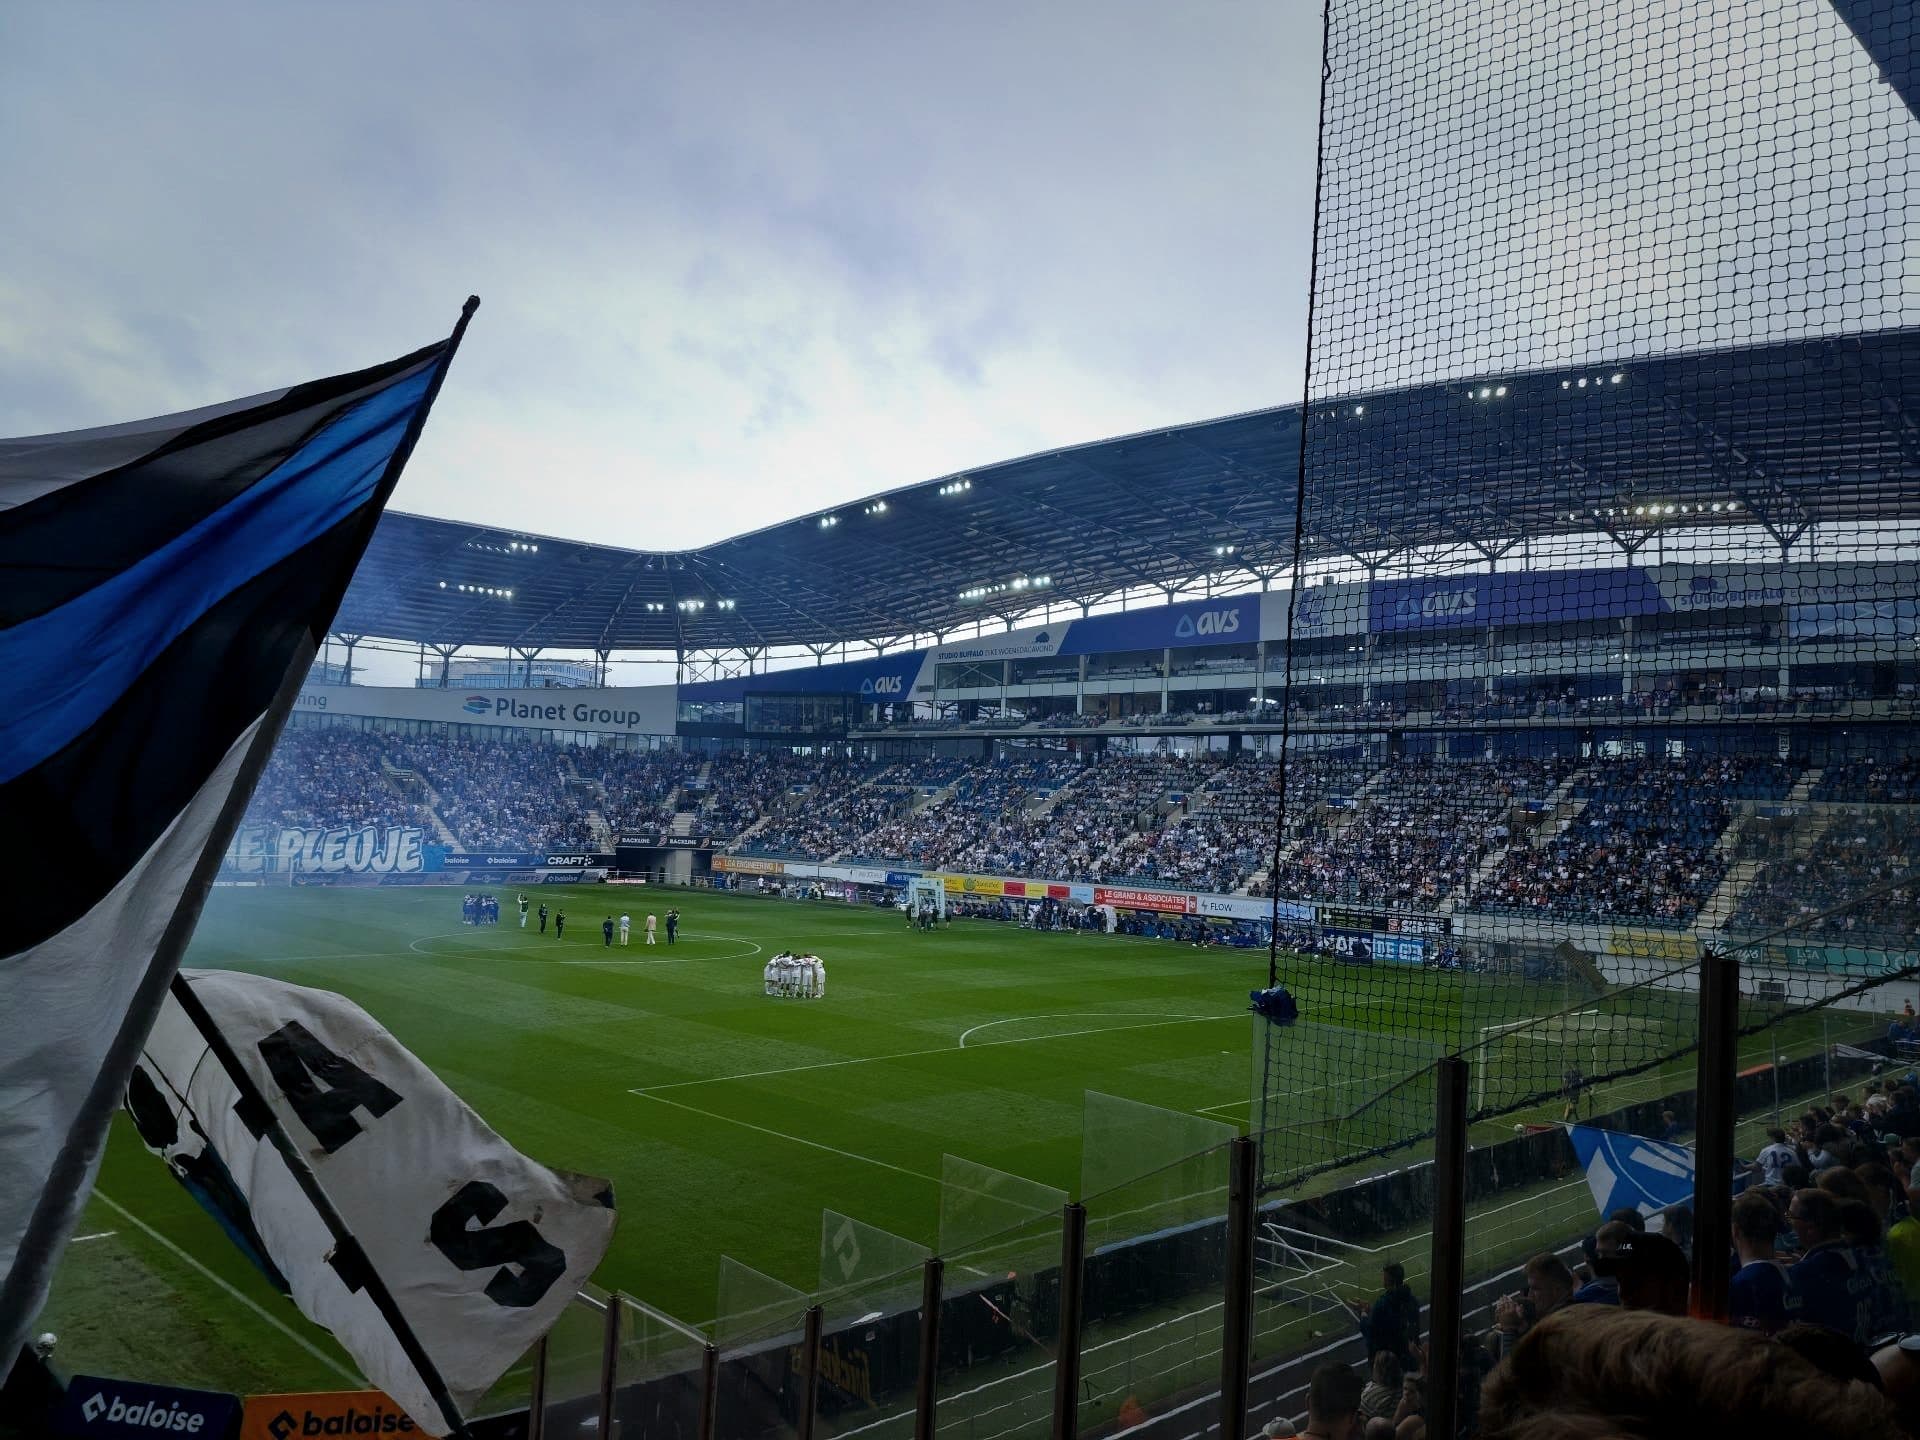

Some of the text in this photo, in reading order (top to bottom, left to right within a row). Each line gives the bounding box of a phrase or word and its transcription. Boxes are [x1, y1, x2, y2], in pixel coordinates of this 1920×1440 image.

[1422, 588, 1477, 618] avs
[1197, 609, 1239, 635] avs
[938, 652, 958, 661] STUDIO
[960, 650, 984, 660] BUFFALO
[875, 676, 902, 694] avs
[496, 697, 640, 728] Planet Group
[622, 837, 651, 845] BACKLINE
[670, 838, 697, 846] BACKLINE
[277, 827, 424, 873] PLEUJE
[445, 857, 470, 865] baloise
[493, 857, 518, 865] baloise
[547, 856, 584, 866] CRAFT
[554, 875, 578, 883] baloise
[1104, 890, 1113, 899] LE
[1114, 891, 1136, 901] GRAND
[1143, 893, 1186, 905] ASSOCIATES
[107, 1396, 205, 1434] baloise
[303, 1405, 416, 1438] baloise
